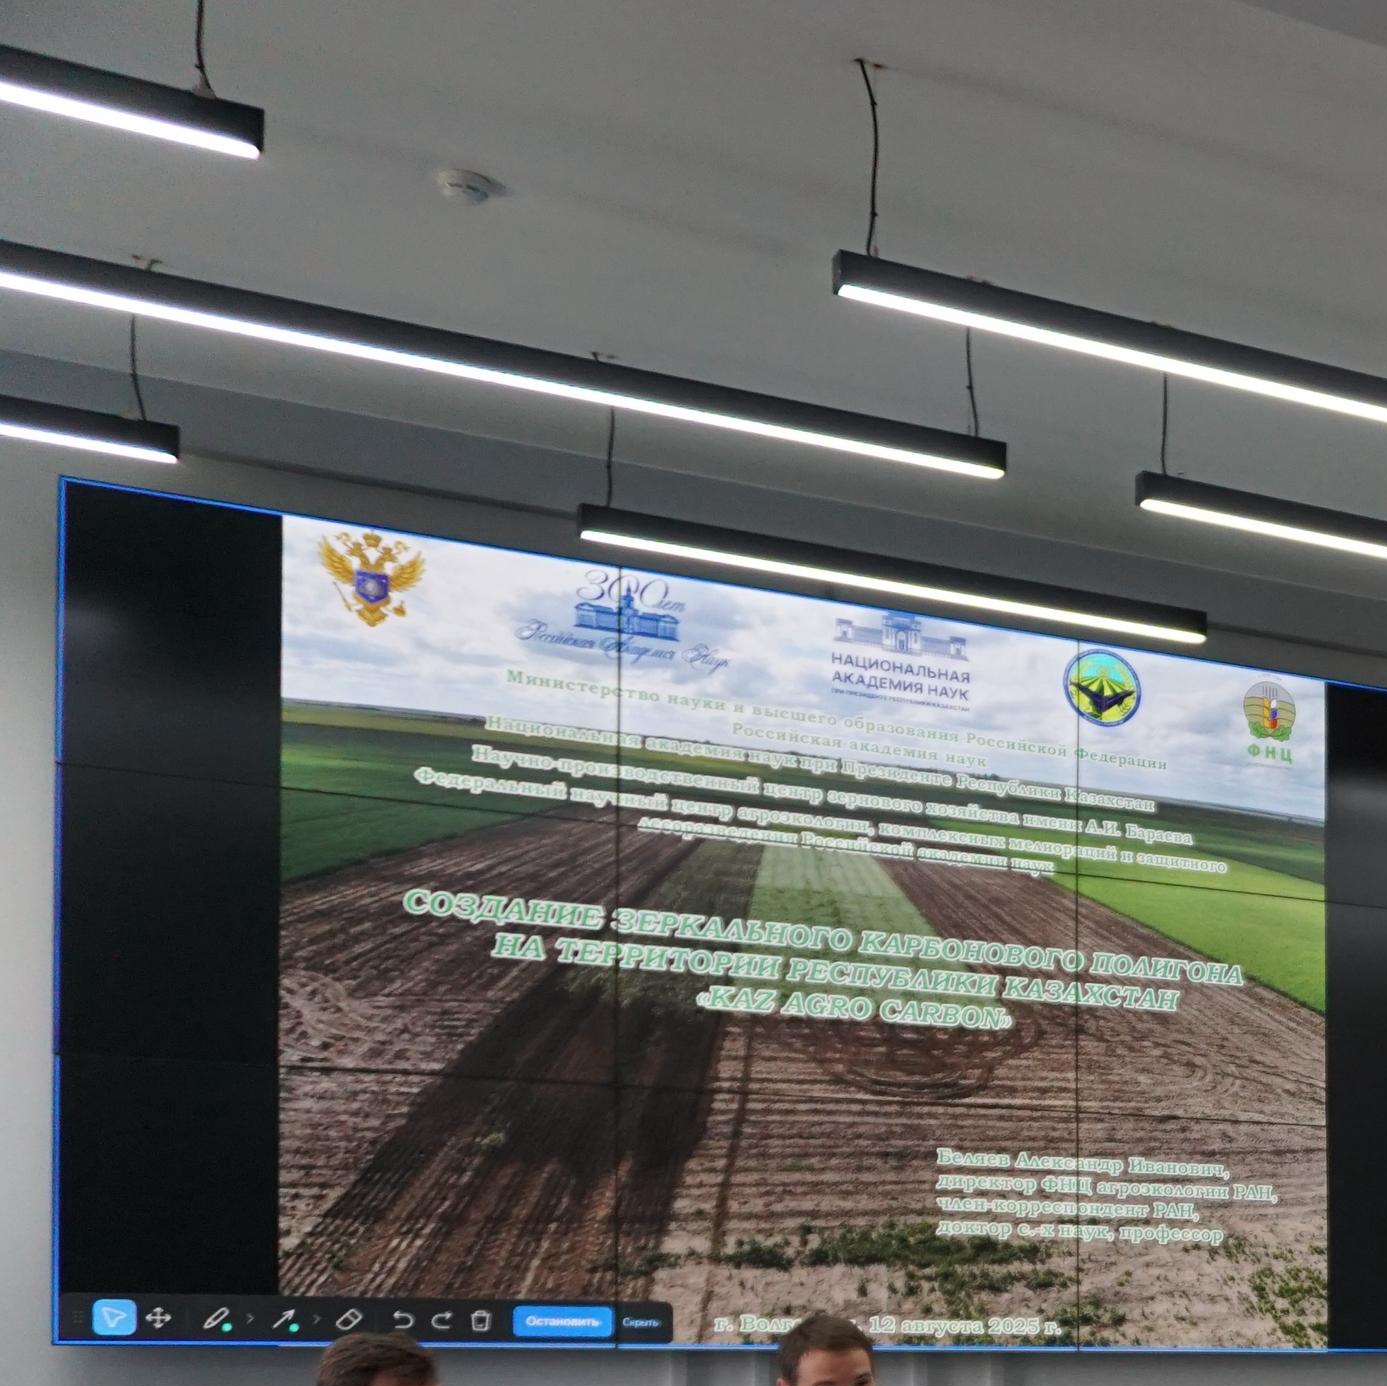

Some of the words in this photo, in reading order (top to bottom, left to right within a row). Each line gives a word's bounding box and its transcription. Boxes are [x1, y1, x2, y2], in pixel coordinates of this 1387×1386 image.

[831, 651, 971, 684] НАЦИОНАЛЬНАЯ
[832, 670, 923, 694] АКАДЕМИЯ
[928, 684, 969, 701] НАУК
[506, 669, 659, 702] Министерство
[668, 692, 726, 713] науки
[734, 704, 744, 714] и
[753, 705, 837, 727] высшего
[844, 716, 959, 743] образования
[966, 732, 1067, 757] Российской
[1074, 747, 1168, 770] Федерации
[731, 722, 842, 748] Российская
[849, 740, 938, 762] академия
[946, 752, 987, 768] наук
[1248, 744, 1292, 764] ФНЦ
[485, 715, 641, 749] Национальная
[645, 738, 746, 762] академия
[748, 750, 797, 770] наук
[801, 756, 839, 774] при
[841, 760, 953, 787] Президенте
[957, 773, 1062, 800] Республики
[1065, 787, 1157, 813] Казахстан
[471, 744, 761, 795] Научно-производственный
[763, 781, 824, 805] центр
[827, 790, 923, 814] зернового
[925, 801, 1020, 825] хозяйства
[1023, 813, 1082, 832] имени
[1085, 818, 1121, 839] А.И.
[1125, 822, 1194, 847] Бараева
[413, 765, 568, 800] Федеральный
[569, 787, 669, 812] научный
[671, 798, 734, 821] центр
[878, 821, 1006, 849] комплексных
[1120, 850, 1134, 863] и
[1136, 850, 1228, 875] защитного
[1010, 856, 1055, 878] наук
[402, 886, 604, 930] СОЗДАНИЕ
[611, 907, 853, 951] ЗЕРКАЛЬНОГО
[858, 930, 1085, 974] КАРБОНОВОГО
[1090, 950, 1245, 987] ПОЛИГОНА
[491, 931, 546, 962] НА
[554, 937, 782, 981] ТЕРРИТОРИИ
[786, 957, 1000, 999] РЕСПУБЛИКИ
[1002, 976, 1181, 1012] КАЗАХСТАН
[780, 991, 873, 1021] AGRO
[936, 1146, 1010, 1168] Беляев
[1015, 1150, 1124, 1176] Александр
[1128, 1155, 1230, 1180] Иванович,
[936, 1174, 1037, 1195] директор
[1040, 1174, 1093, 1196] ФНЦ
[1096, 1181, 1230, 1199] агроэкологии
[1232, 1183, 1279, 1204] РАН,
[936, 1196, 1150, 1219] член-корреспондент
[1153, 1201, 1199, 1222] РАН,
[936, 1219, 1012, 1240] доктор
[1058, 1223, 1115, 1242] наук,
[1119, 1223, 1224, 1246] профессор
[525, 1315, 601, 1328] Остановить
[622, 1316, 660, 1328] Скрыть
[714, 1316, 734, 1333] г.
[868, 1314, 897, 1335] 12
[901, 1317, 985, 1337] августа
[988, 1317, 1040, 1335] 2025
[1044, 1319, 1063, 1335] г.
